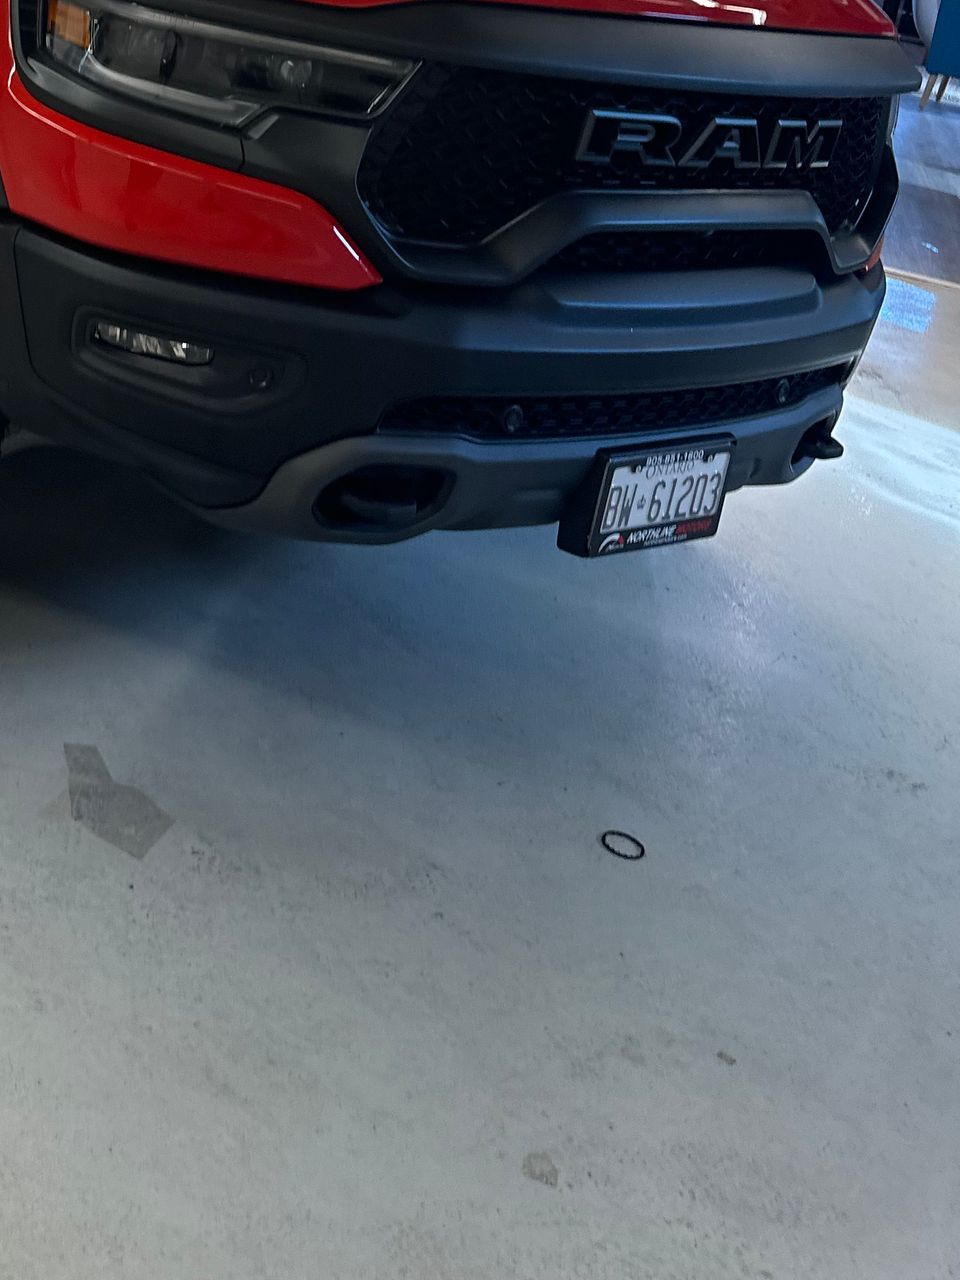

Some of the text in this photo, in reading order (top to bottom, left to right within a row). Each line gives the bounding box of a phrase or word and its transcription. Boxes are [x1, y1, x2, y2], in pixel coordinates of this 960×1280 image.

[575, 108, 844, 170] RAM
[645, 460, 695, 480] ONTARIO
[602, 484, 638, 530] BW
[647, 472, 721, 522] 61203
